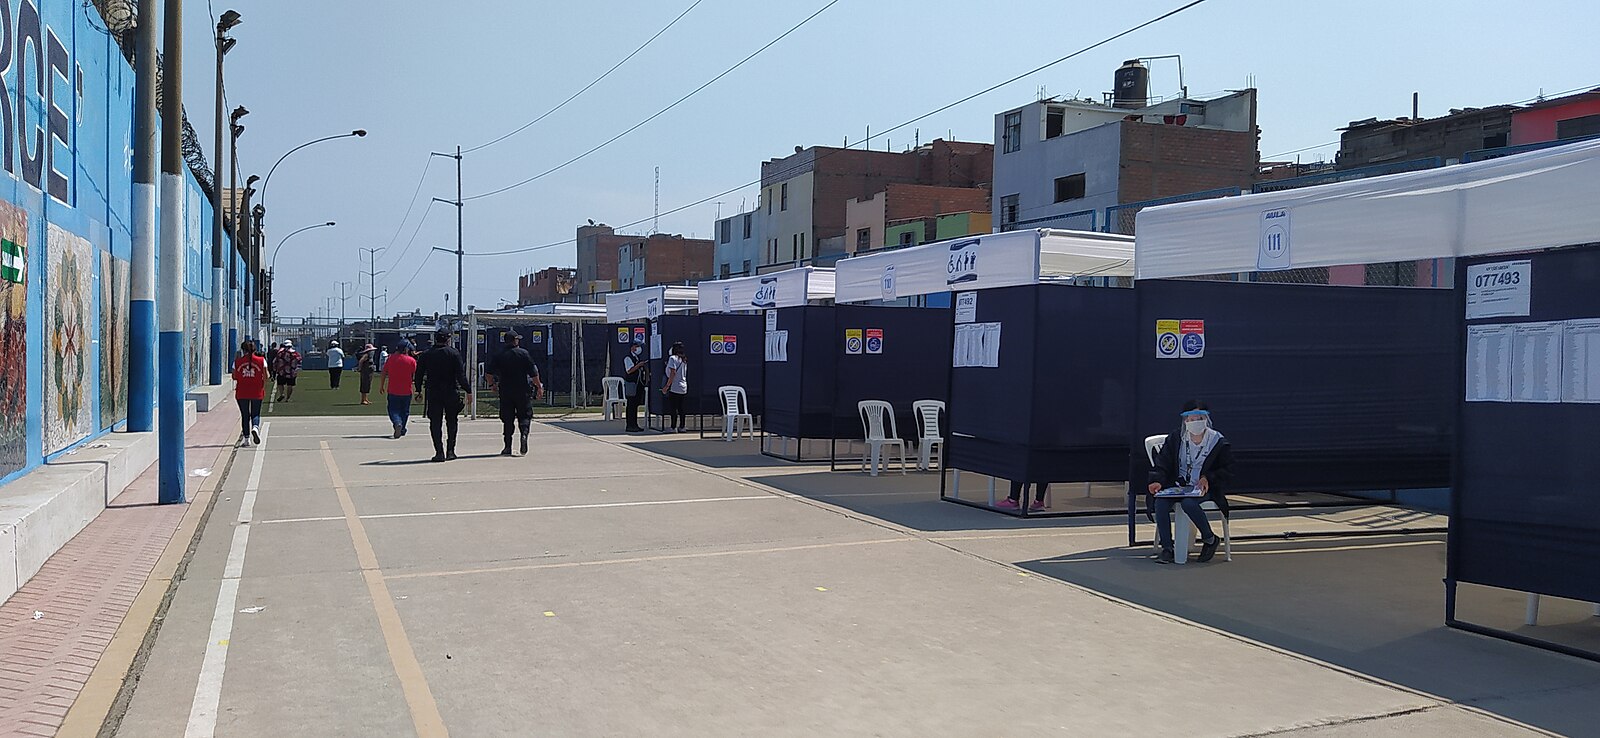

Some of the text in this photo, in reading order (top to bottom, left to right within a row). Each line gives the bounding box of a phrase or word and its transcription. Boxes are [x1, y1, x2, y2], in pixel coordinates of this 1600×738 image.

[1265, 211, 1286, 220] AULA
[1267, 233, 1281, 252] 111
[1475, 271, 1521, 288] 077493
